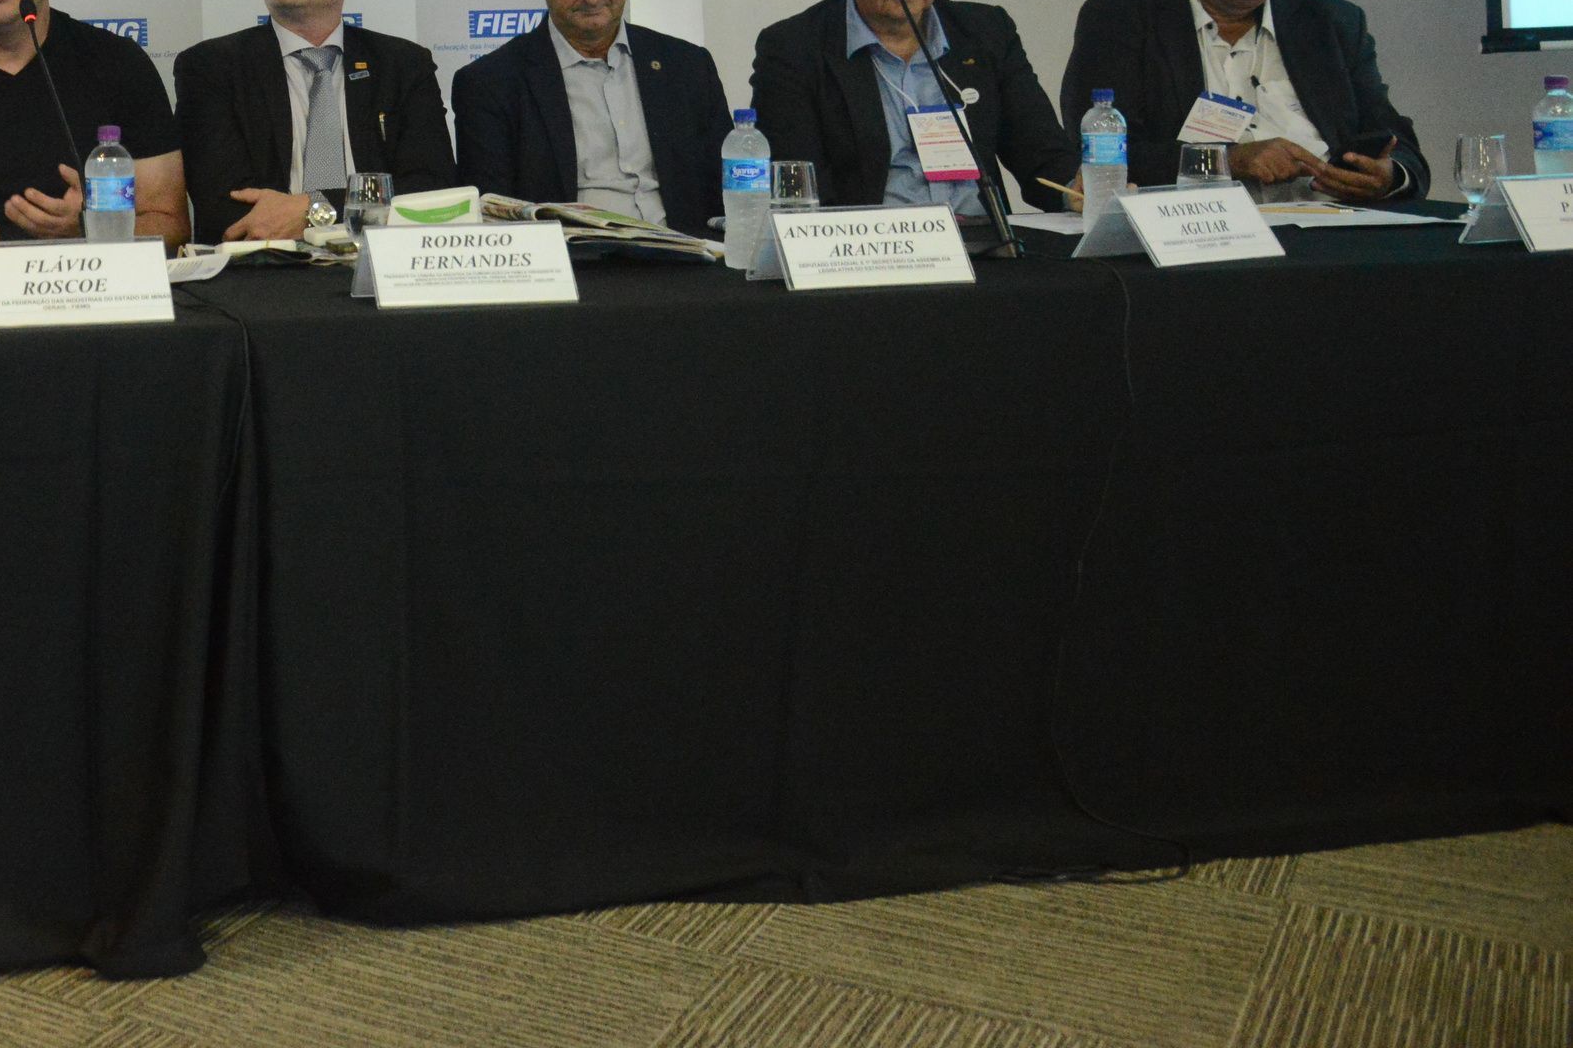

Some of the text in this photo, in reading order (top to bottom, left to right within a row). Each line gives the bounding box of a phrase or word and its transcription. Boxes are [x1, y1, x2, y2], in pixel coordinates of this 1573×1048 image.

[476, 12, 543, 34] FIEM
[1157, 200, 1227, 218] MAYRINCK
[783, 219, 946, 238] ANTONIO CARLOS
[1181, 219, 1230, 236] AGUIAR
[421, 234, 513, 248] RODRIGO
[829, 240, 914, 257] ARANTES
[25, 255, 102, 274] FLÁVIO
[411, 253, 532, 270] FERNANDES
[23, 278, 107, 295] ROSCOE
